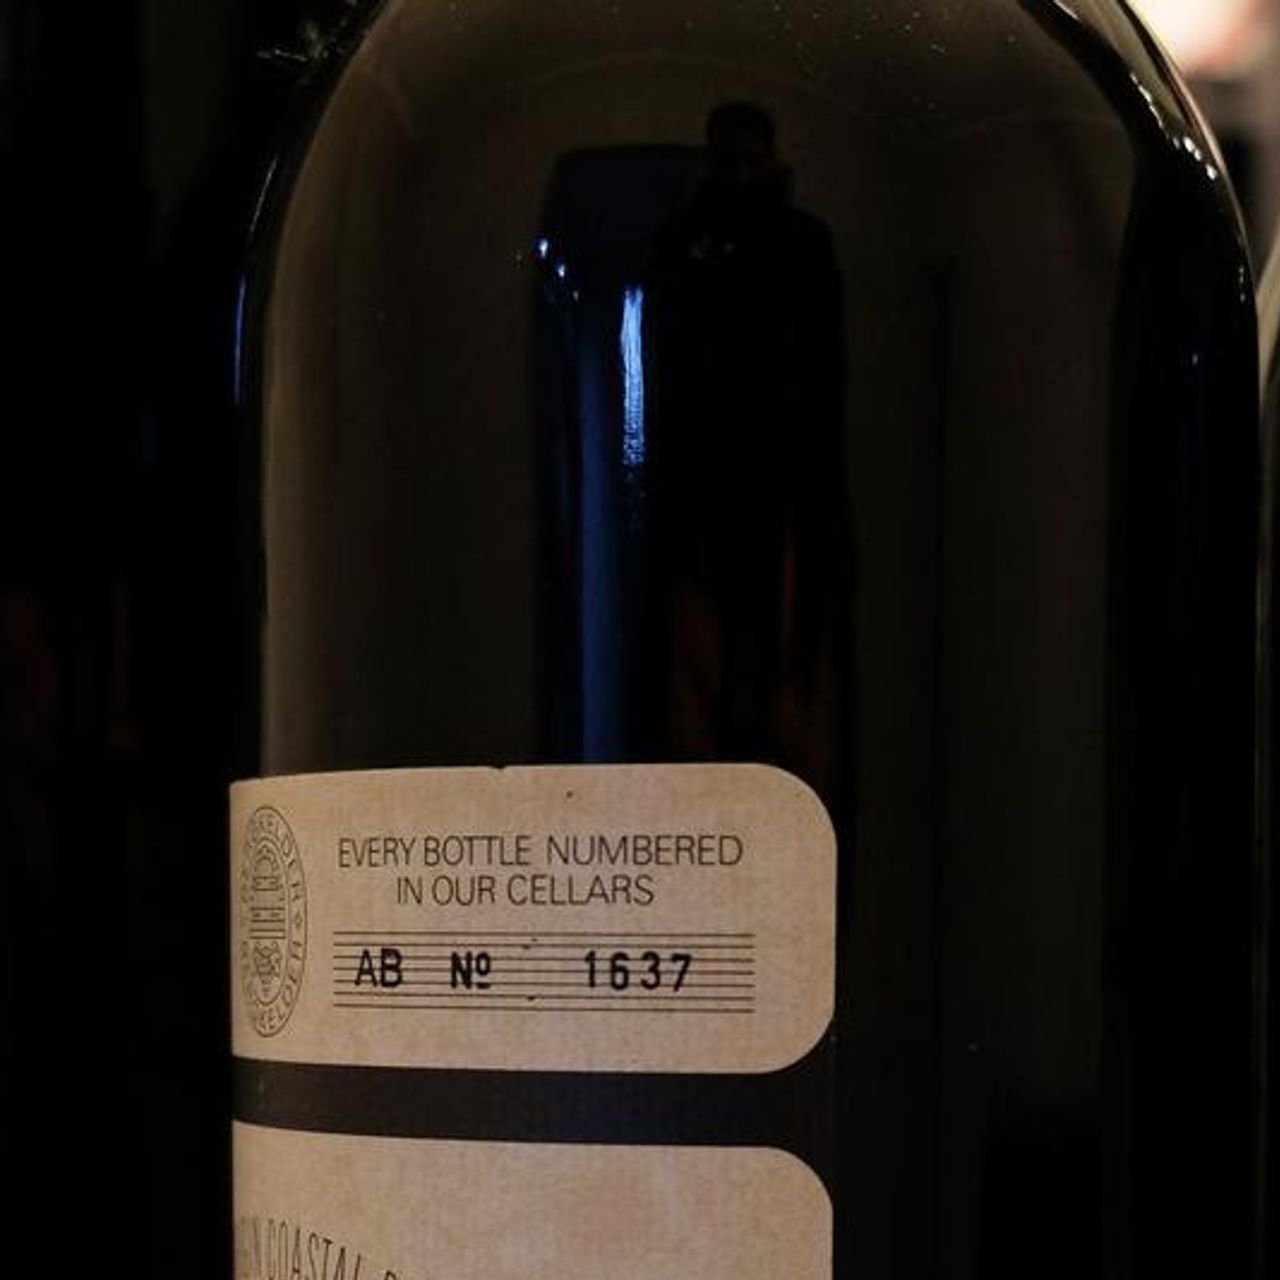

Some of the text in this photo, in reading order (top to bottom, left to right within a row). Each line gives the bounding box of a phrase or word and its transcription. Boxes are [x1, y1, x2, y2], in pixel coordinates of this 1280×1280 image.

[337, 834, 743, 868] EVERY BOTTLE NUMBERED
[397, 874, 655, 906] IN OUR CELLARS
[354, 948, 404, 989] AB
[583, 950, 693, 992] 1637
